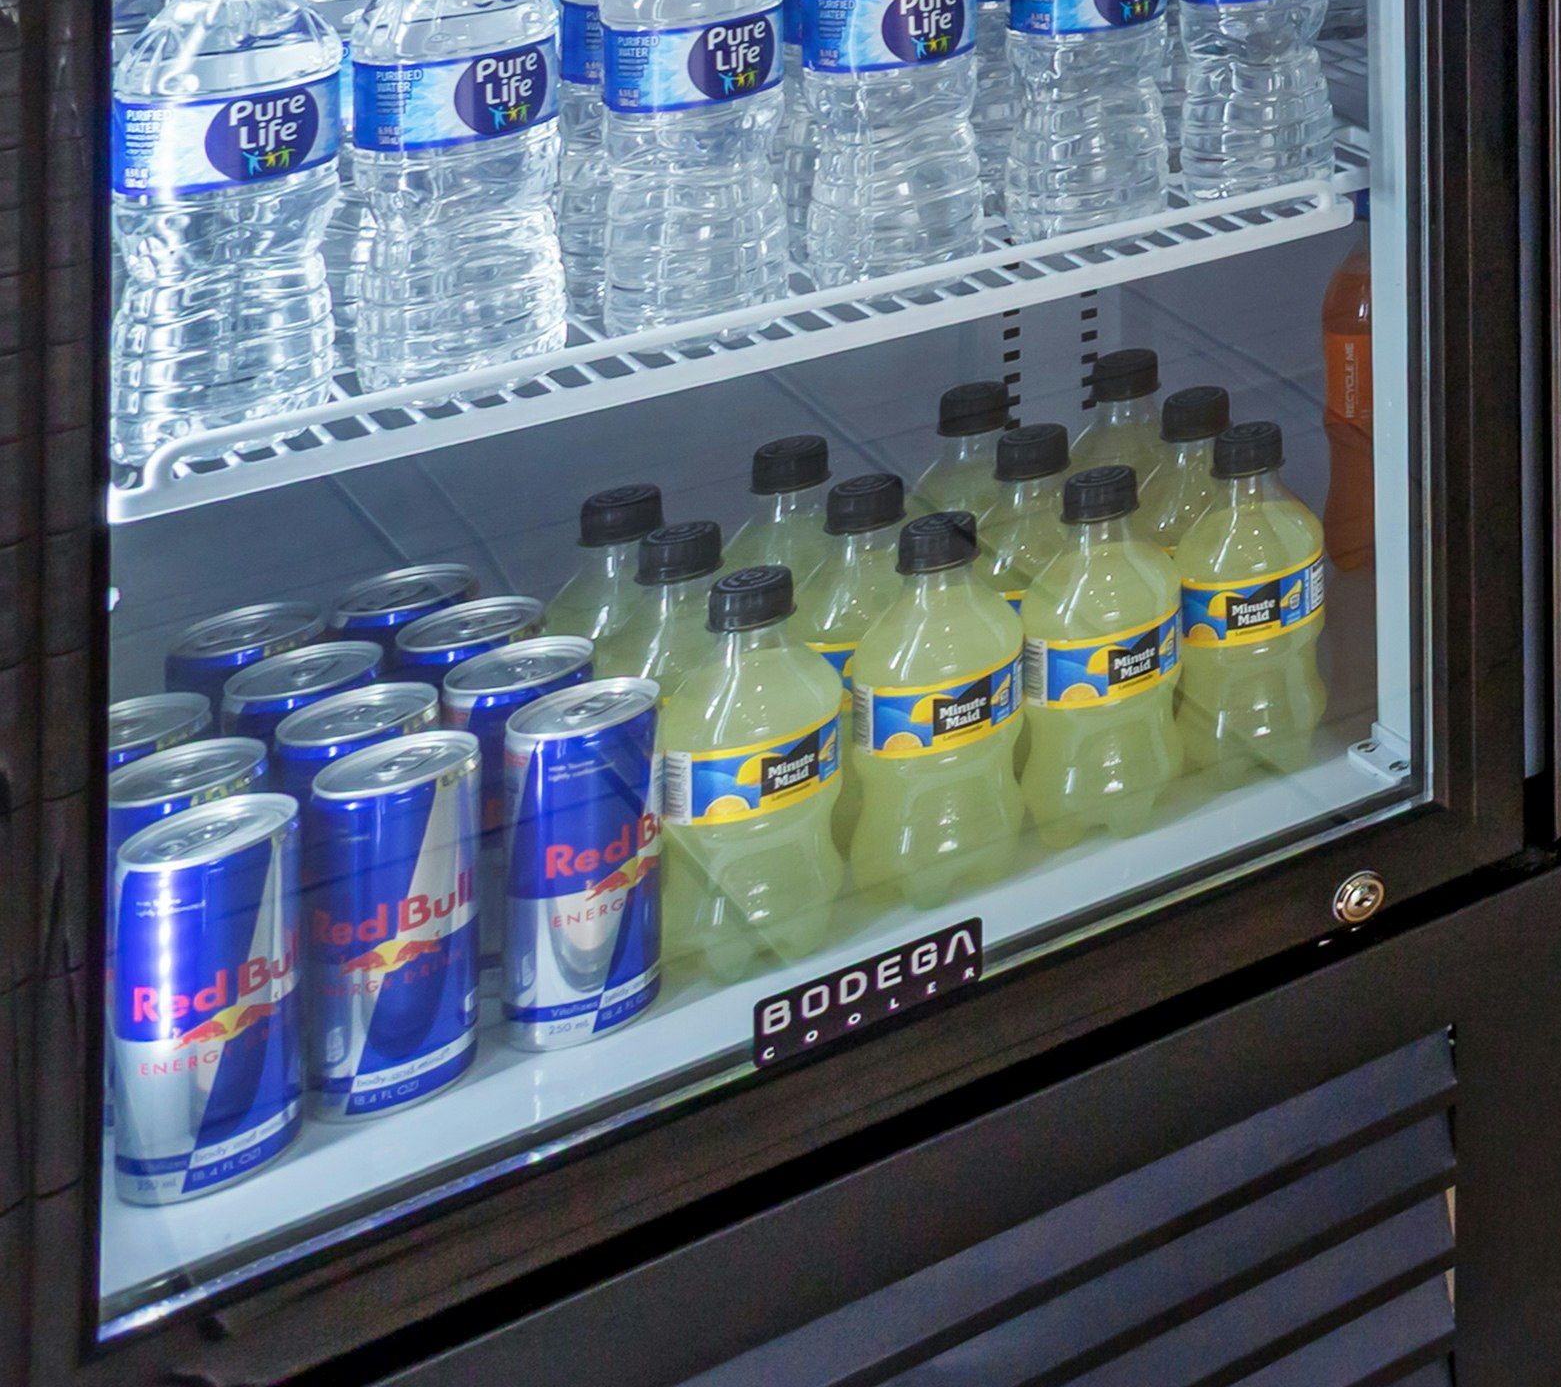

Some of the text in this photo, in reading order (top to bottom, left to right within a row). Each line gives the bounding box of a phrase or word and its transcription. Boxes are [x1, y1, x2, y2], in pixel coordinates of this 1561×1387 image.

[706, 20, 766, 51] Pure
[908, 10, 953, 39] Life
[475, 50, 538, 83] Pure
[715, 43, 761, 74] Life
[484, 73, 534, 106] Life
[229, 94, 306, 127] Pure
[238, 119, 299, 153] Life
[1231, 596, 1276, 618] Minute
[1236, 608, 1271, 627] Maid
[1113, 645, 1157, 671] Minute
[1119, 657, 1152, 680] Maid
[938, 695, 987, 720] Minute
[945, 709, 981, 730] Maid
[767, 751, 815, 779] Minute
[774, 766, 810, 789] Maid
[545, 823, 631, 880] Red
[399, 866, 474, 933] Bull
[133, 969, 229, 1023] Red
[762, 929, 976, 1036] BODEGA
[761, 965, 975, 1061] COOLER
